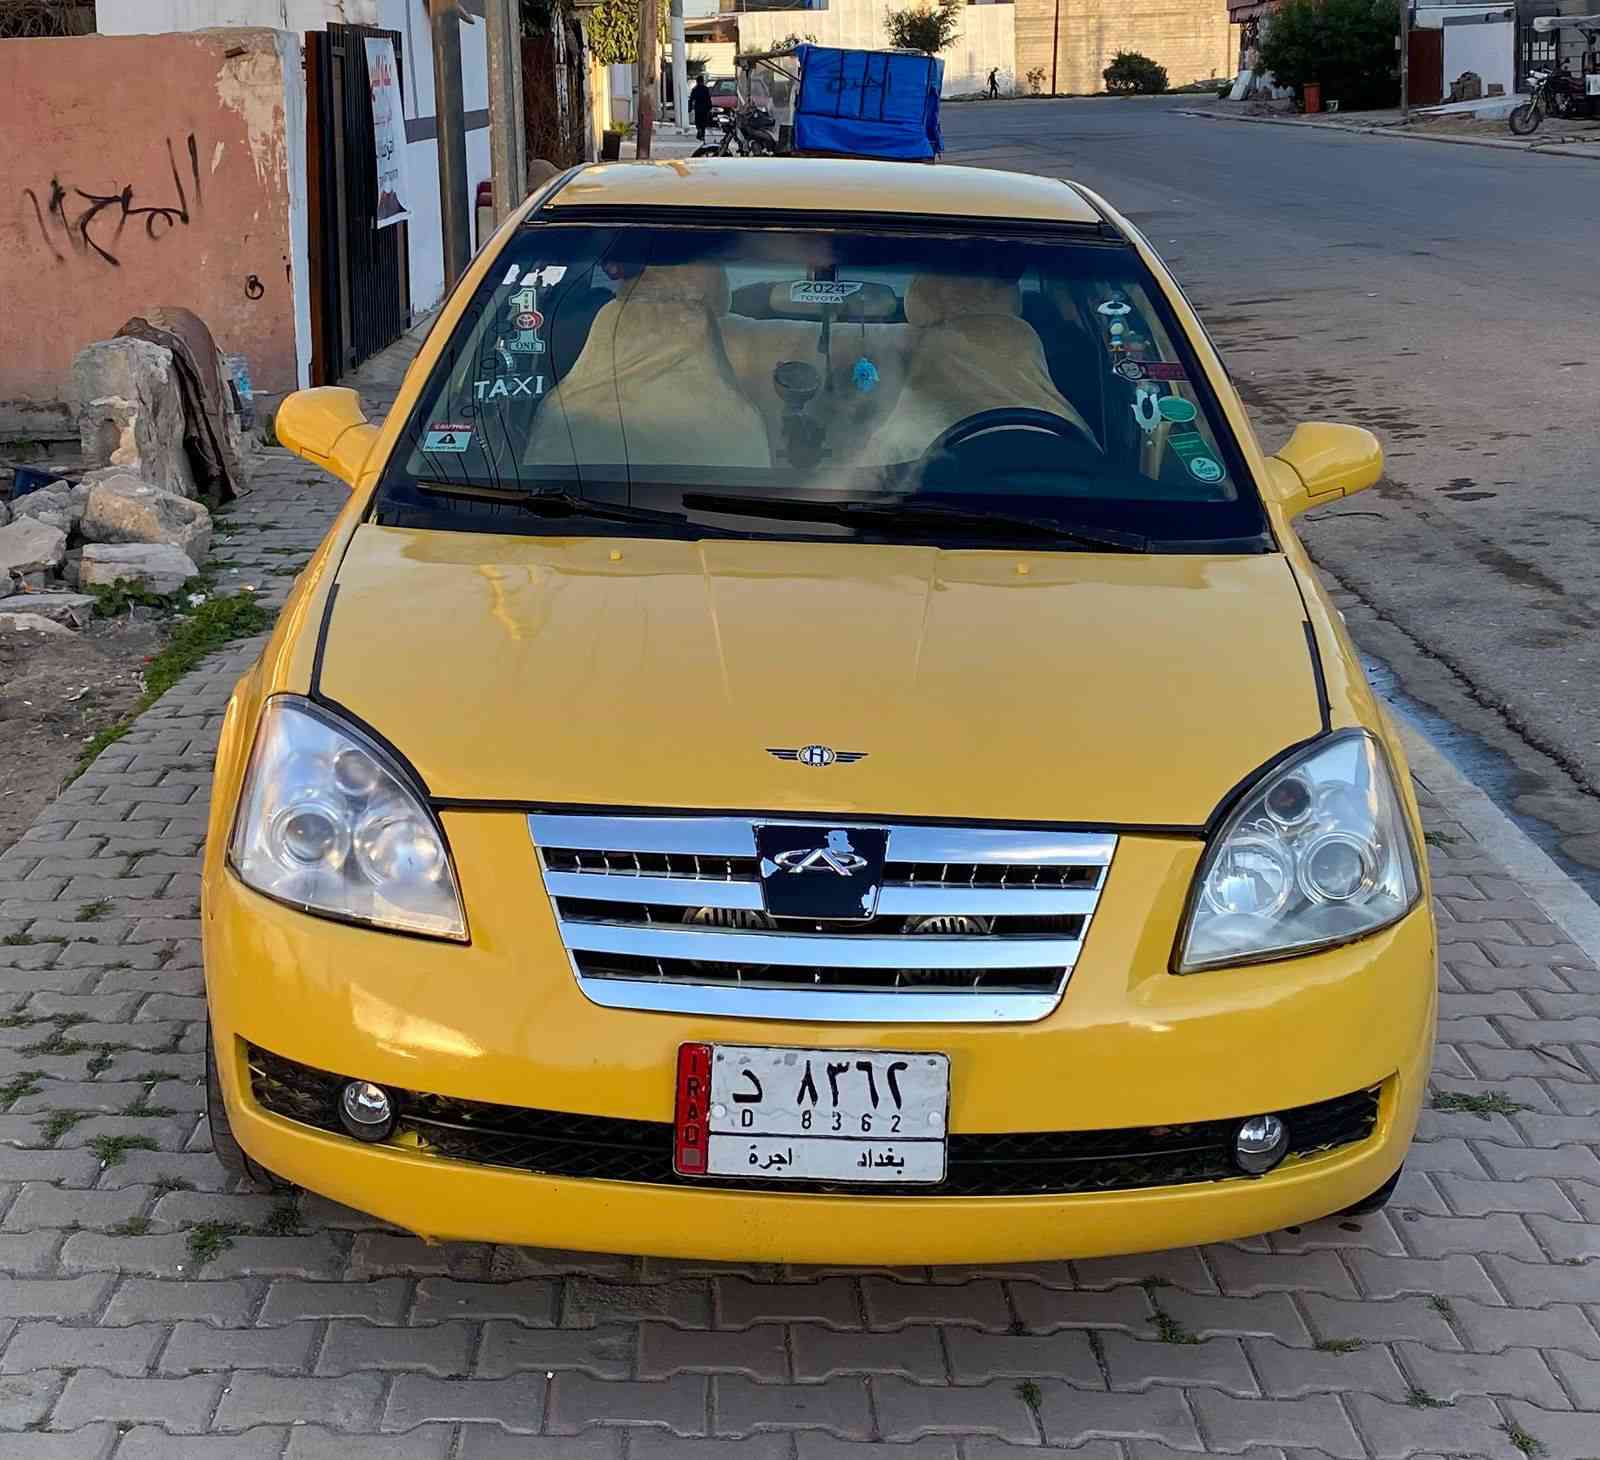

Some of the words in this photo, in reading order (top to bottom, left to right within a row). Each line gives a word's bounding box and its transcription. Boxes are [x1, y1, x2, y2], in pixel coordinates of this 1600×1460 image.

[801, 282, 846, 294] 2024
[474, 375, 544, 399] TAXI
[732, 1069, 763, 1103] د
[797, 1059, 908, 1110] ٨٣٦٢
[684, 1055, 699, 1144] IRAQ
[741, 1109, 754, 1128] D
[801, 1110, 901, 1133] 8362
[748, 1144, 793, 1172] اجرة
[857, 1147, 905, 1175] بغداد
